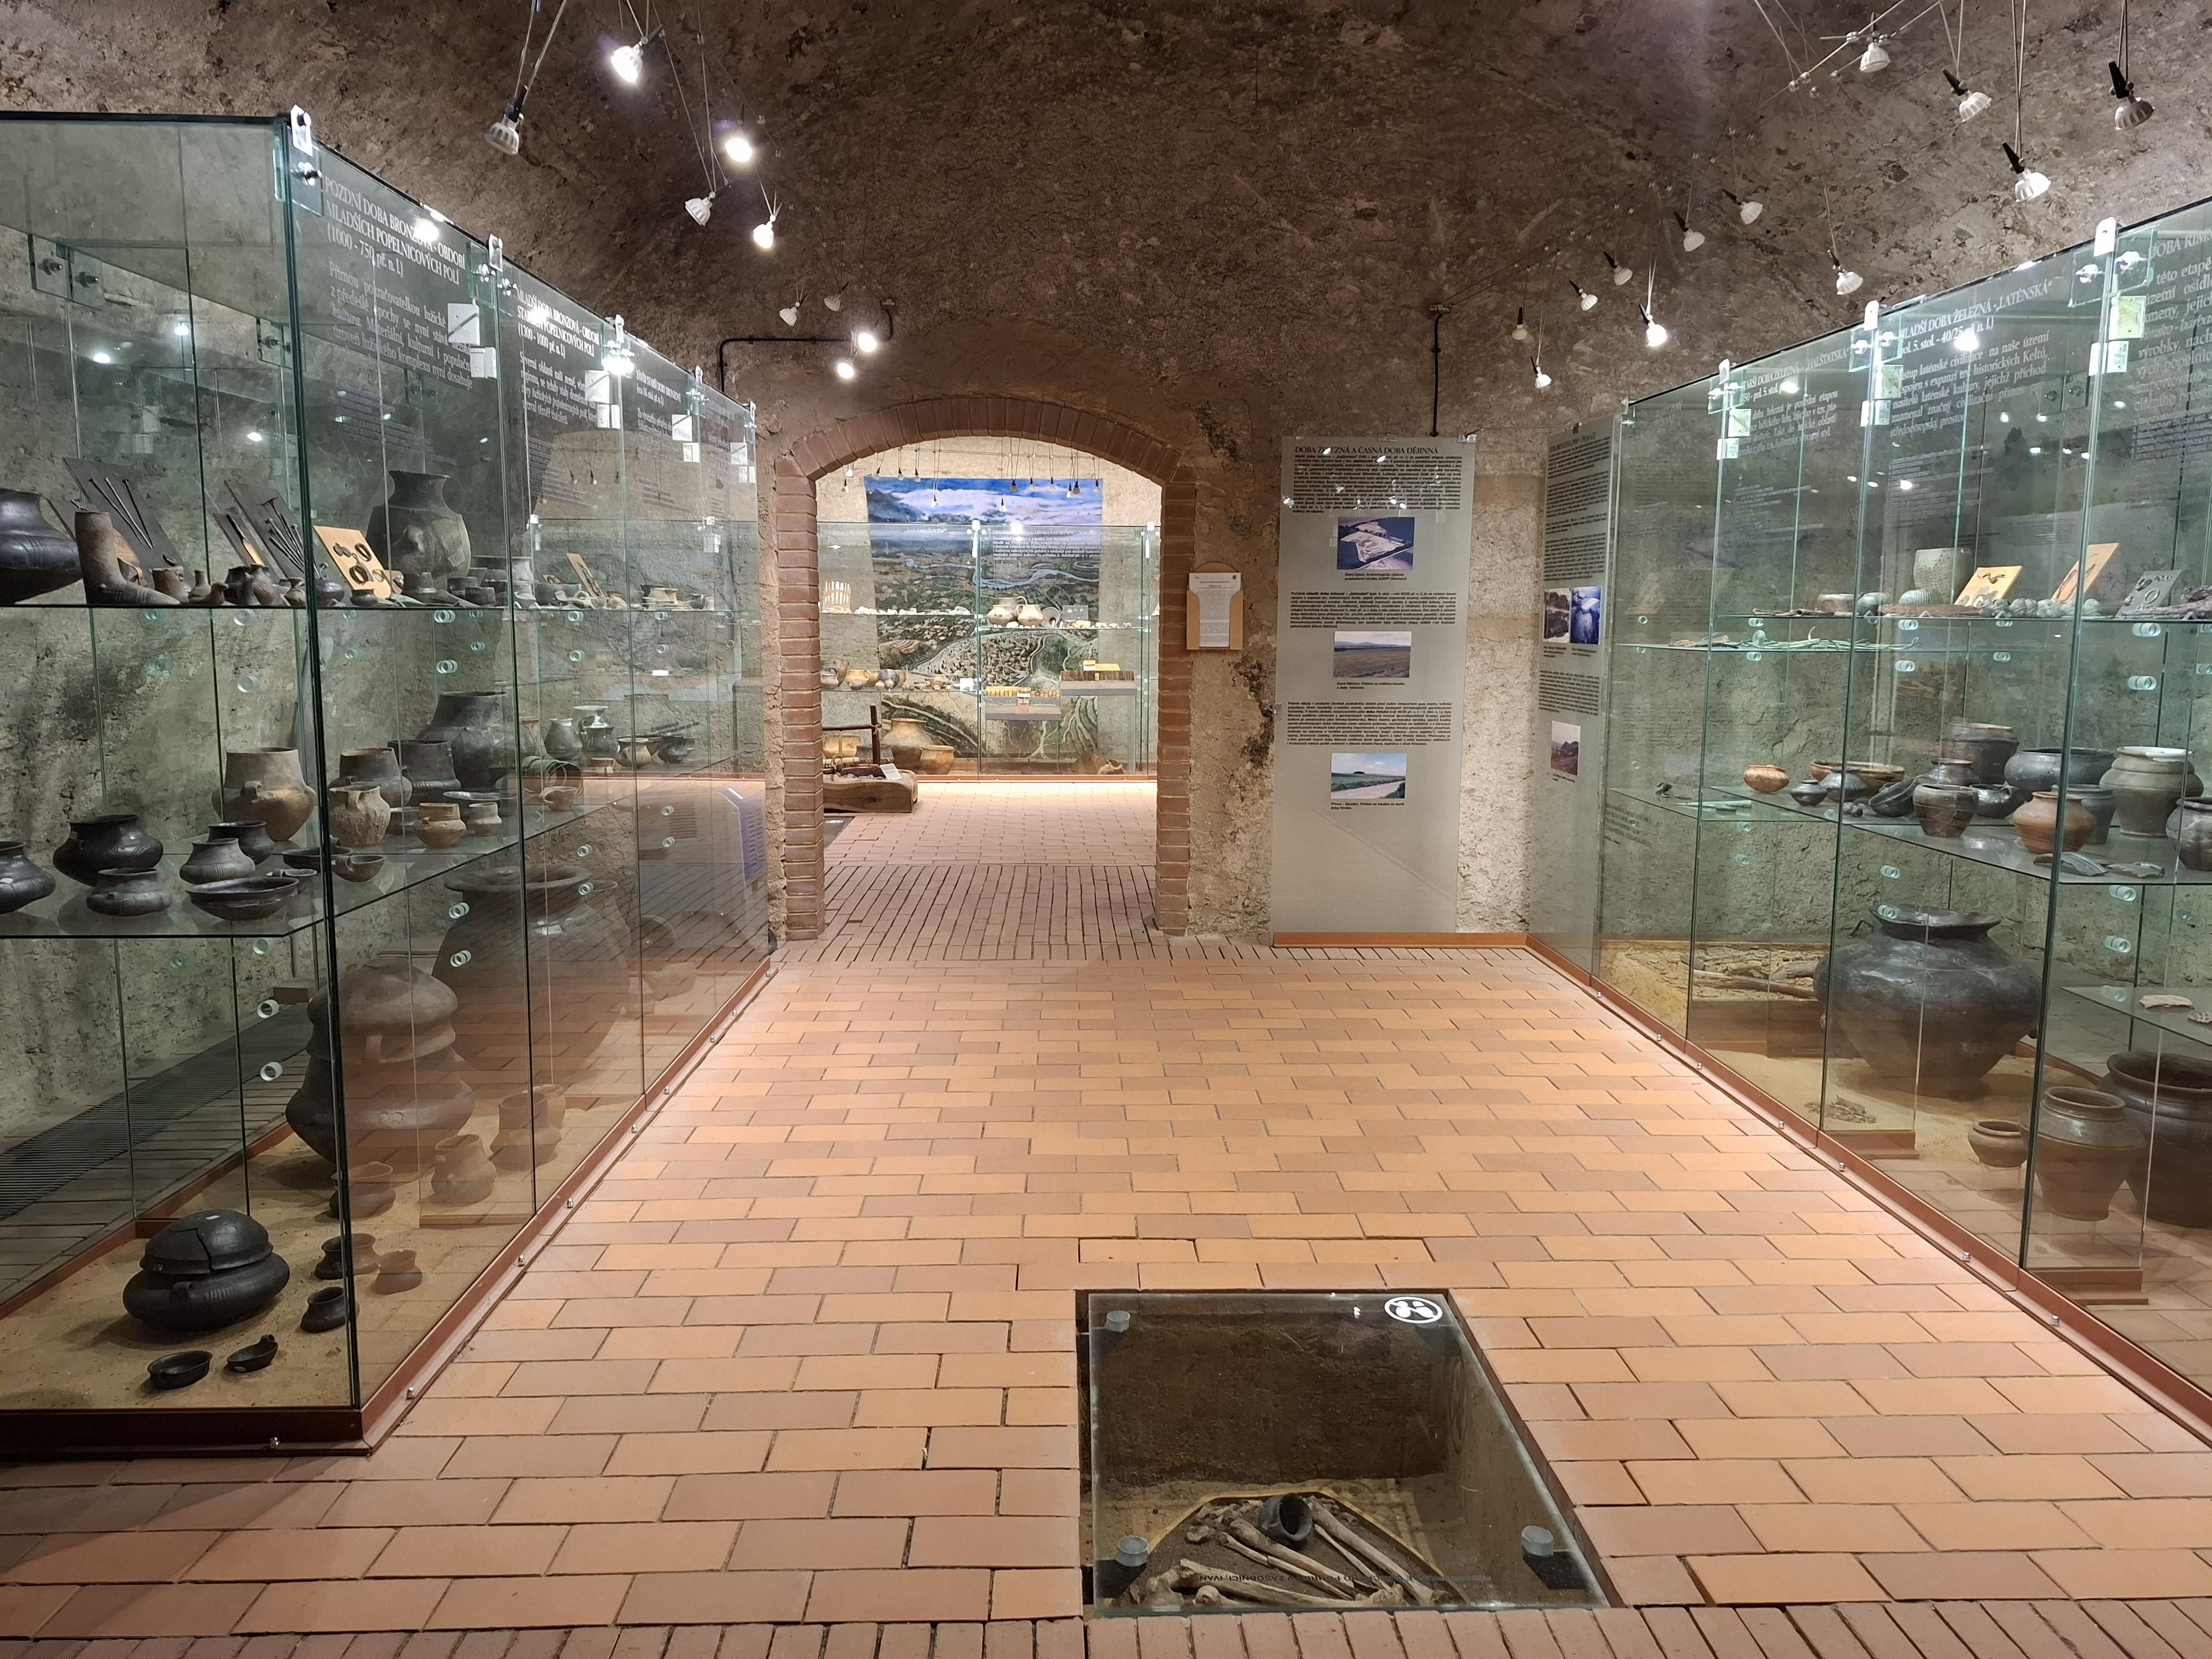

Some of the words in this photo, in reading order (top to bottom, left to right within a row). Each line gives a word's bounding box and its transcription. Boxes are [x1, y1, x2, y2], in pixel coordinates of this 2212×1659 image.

[325, 176, 361, 211] POZDNÍ
[363, 198, 388, 226] DOBA
[389, 213, 433, 252] BRONZ
[438, 242, 466, 270] OBDOBÍ
[326, 200, 375, 241] MLADŠÍCH
[377, 229, 442, 276] POPELNICOVÝCH
[444, 264, 460, 285] POLÍ
[327, 223, 352, 250] (1000
[359, 240, 374, 261] 750
[376, 252, 387, 269] př.
[388, 259, 395, 272] n.
[2157, 269, 2178, 285] této
[2181, 257, 2212, 276] etapě
[424, 305, 446, 328] lužické
[553, 309, 580, 335] BRONZOVÁ
[582, 326, 599, 346] OBDOBÍ
[1928, 315, 1952, 332] DOBA
[1953, 298, 1992, 323] ŽELEZNÁ
[403, 317, 411, 330] se
[415, 322, 429, 338] nyní
[432, 331, 448, 346] stává
[518, 322, 533, 341] (1300
[537, 332, 549, 349] 1000
[556, 345, 561, 355] n.
[544, 321, 584, 352] POPELNICOVÝCH
[584, 341, 594, 357] POLÍ
[1913, 340, 1919, 352] 5.
[1921, 334, 1935, 348] stol.
[1977, 322, 1984, 332] n.
[408, 333, 434, 357] kulturní
[437, 347, 440, 359] i
[444, 351, 470, 370] populačn
[1919, 358, 1948, 375] laténské
[1989, 347, 1999, 357] na
[2002, 340, 2020, 353] naše
[2023, 330, 2050, 347] území
[2138, 338, 2181, 360] výrobky,
[432, 366, 446, 379] nyní
[447, 371, 473, 390] dosahuje
[538, 360, 553, 377] oblasti
[1757, 373, 1773, 386] DOBA
[1901, 381, 1923, 396] spojen
[1924, 379, 1929, 388] s
[1930, 369, 1958, 387] expanzí
[1974, 352, 2020, 375] historických
[540, 378, 545, 388] se
[546, 379, 559, 396] tehdy
[559, 385, 569, 400] staly
[657, 382, 666, 394] DOBY
[1753, 388, 1762, 402] pol.
[1768, 383, 1778, 395] stol.
[1892, 393, 1918, 409] nositelů
[1921, 386, 1950, 402] laténské
[1984, 372, 2010, 390] jejichž
[2013, 361, 2046, 383] příchod
[1786, 401, 1792, 417] je
[1819, 390, 1838, 403] etapou
[1891, 405, 1923, 422] znamenal
[1927, 400, 1952, 415] značný
[1787, 422, 1794, 434] do
[1318, 445, 1349, 453] ŽEZNÁ
[1407, 446, 1438, 455] DĚJINNÁ
